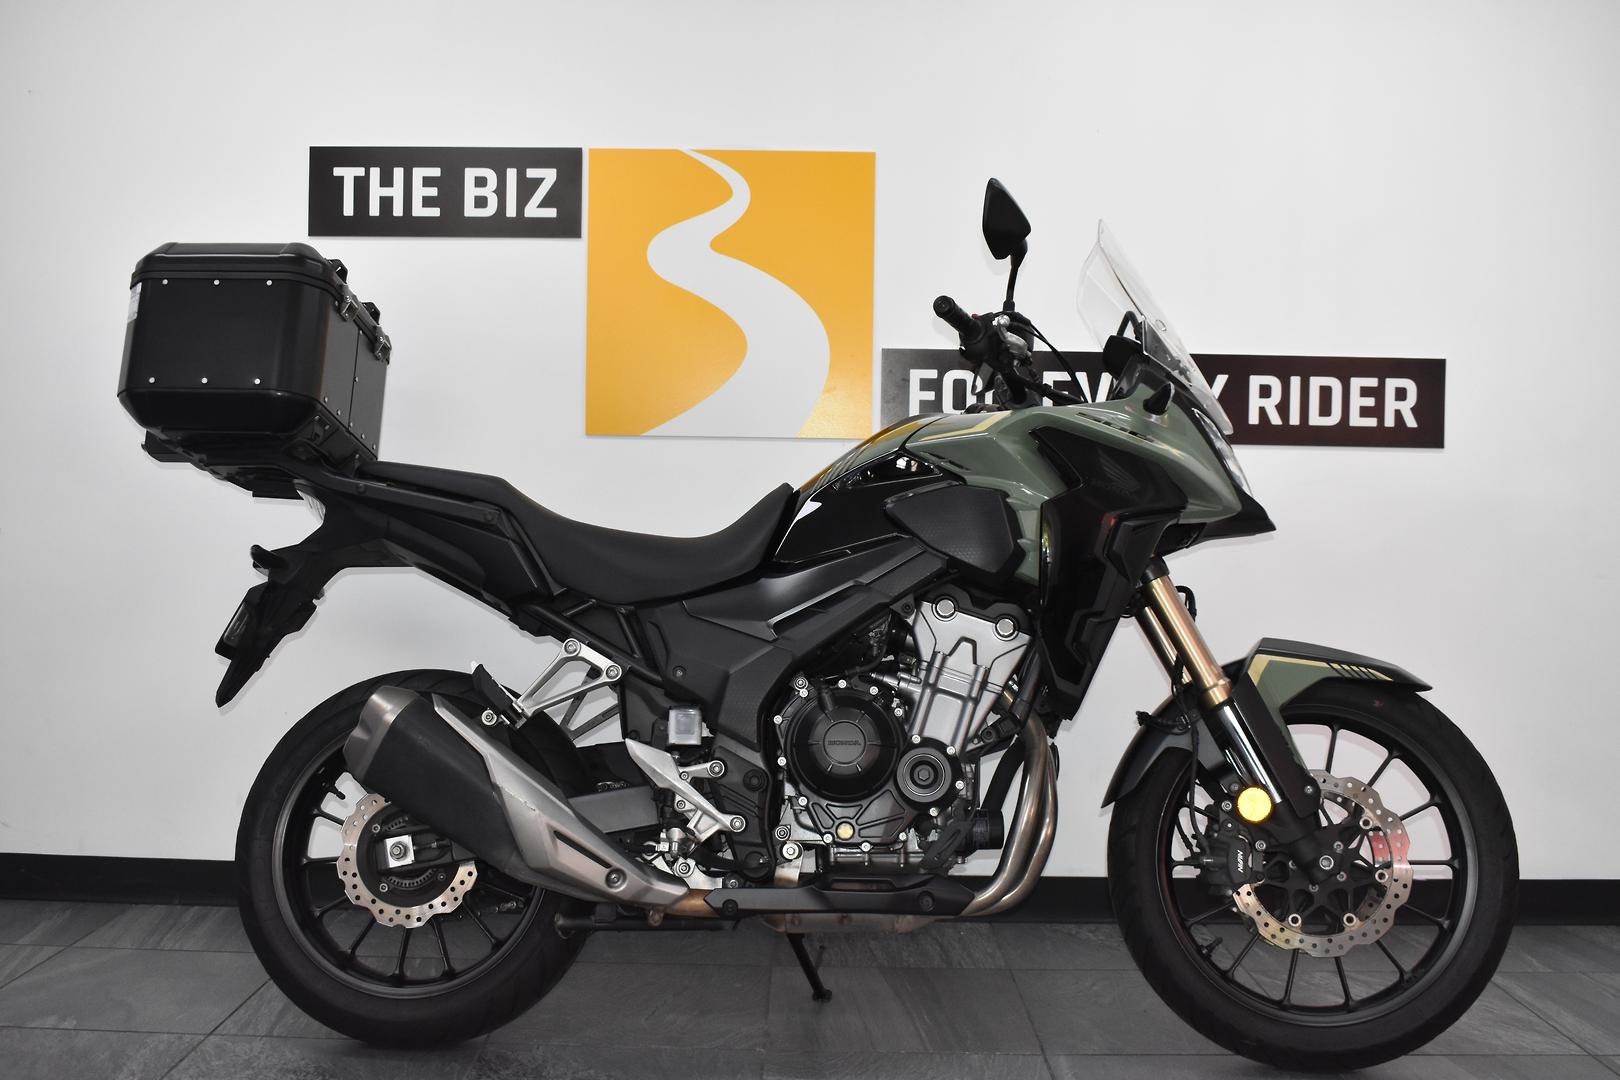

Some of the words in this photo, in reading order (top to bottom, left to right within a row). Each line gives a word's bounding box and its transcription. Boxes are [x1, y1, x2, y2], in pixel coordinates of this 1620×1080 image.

[333, 167, 441, 216] THE
[464, 167, 558, 218] BIZ
[908, 369, 996, 417] FO
[1248, 375, 1418, 428] RIDER
